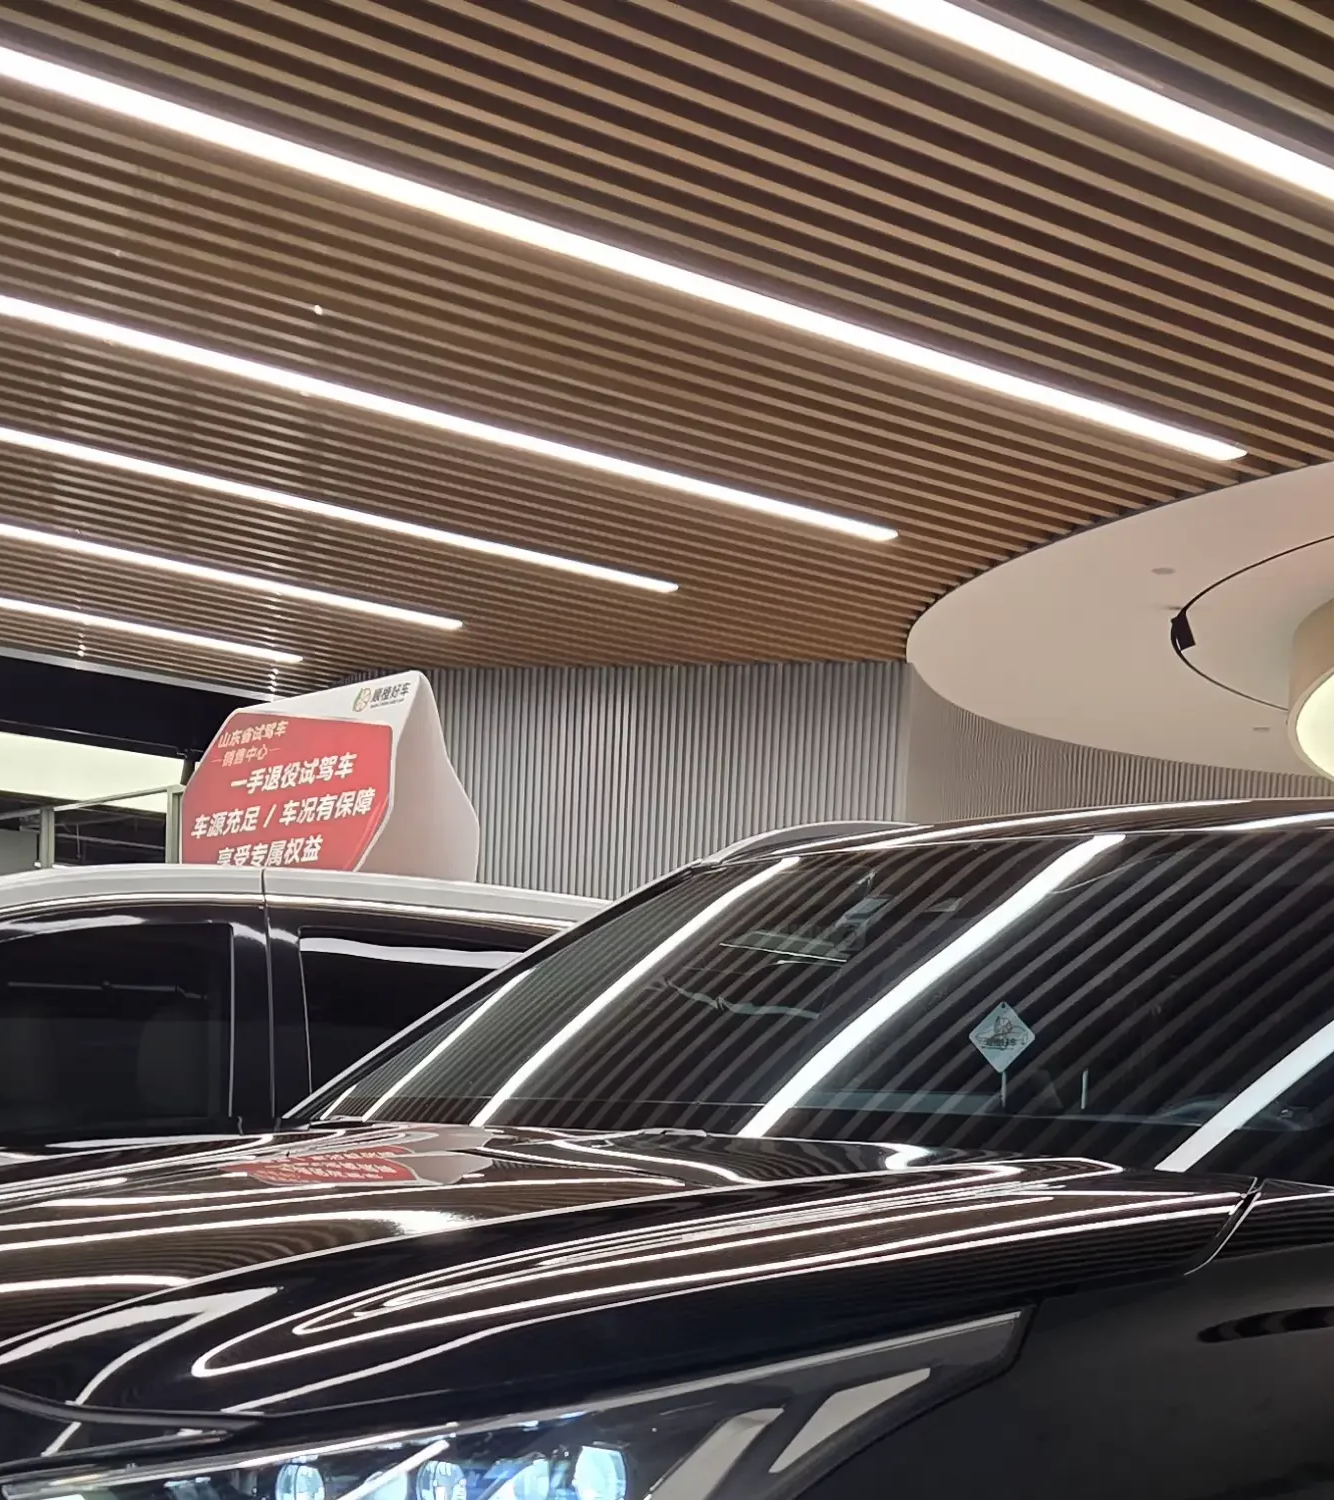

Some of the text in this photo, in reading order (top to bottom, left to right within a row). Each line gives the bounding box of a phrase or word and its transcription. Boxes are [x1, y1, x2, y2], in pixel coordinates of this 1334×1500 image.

[230, 752, 357, 795] 一手退役试驾车
[190, 806, 261, 839] 车源充足
[279, 787, 376, 826] 车况有保障
[216, 834, 323, 868] 享受专属权益
